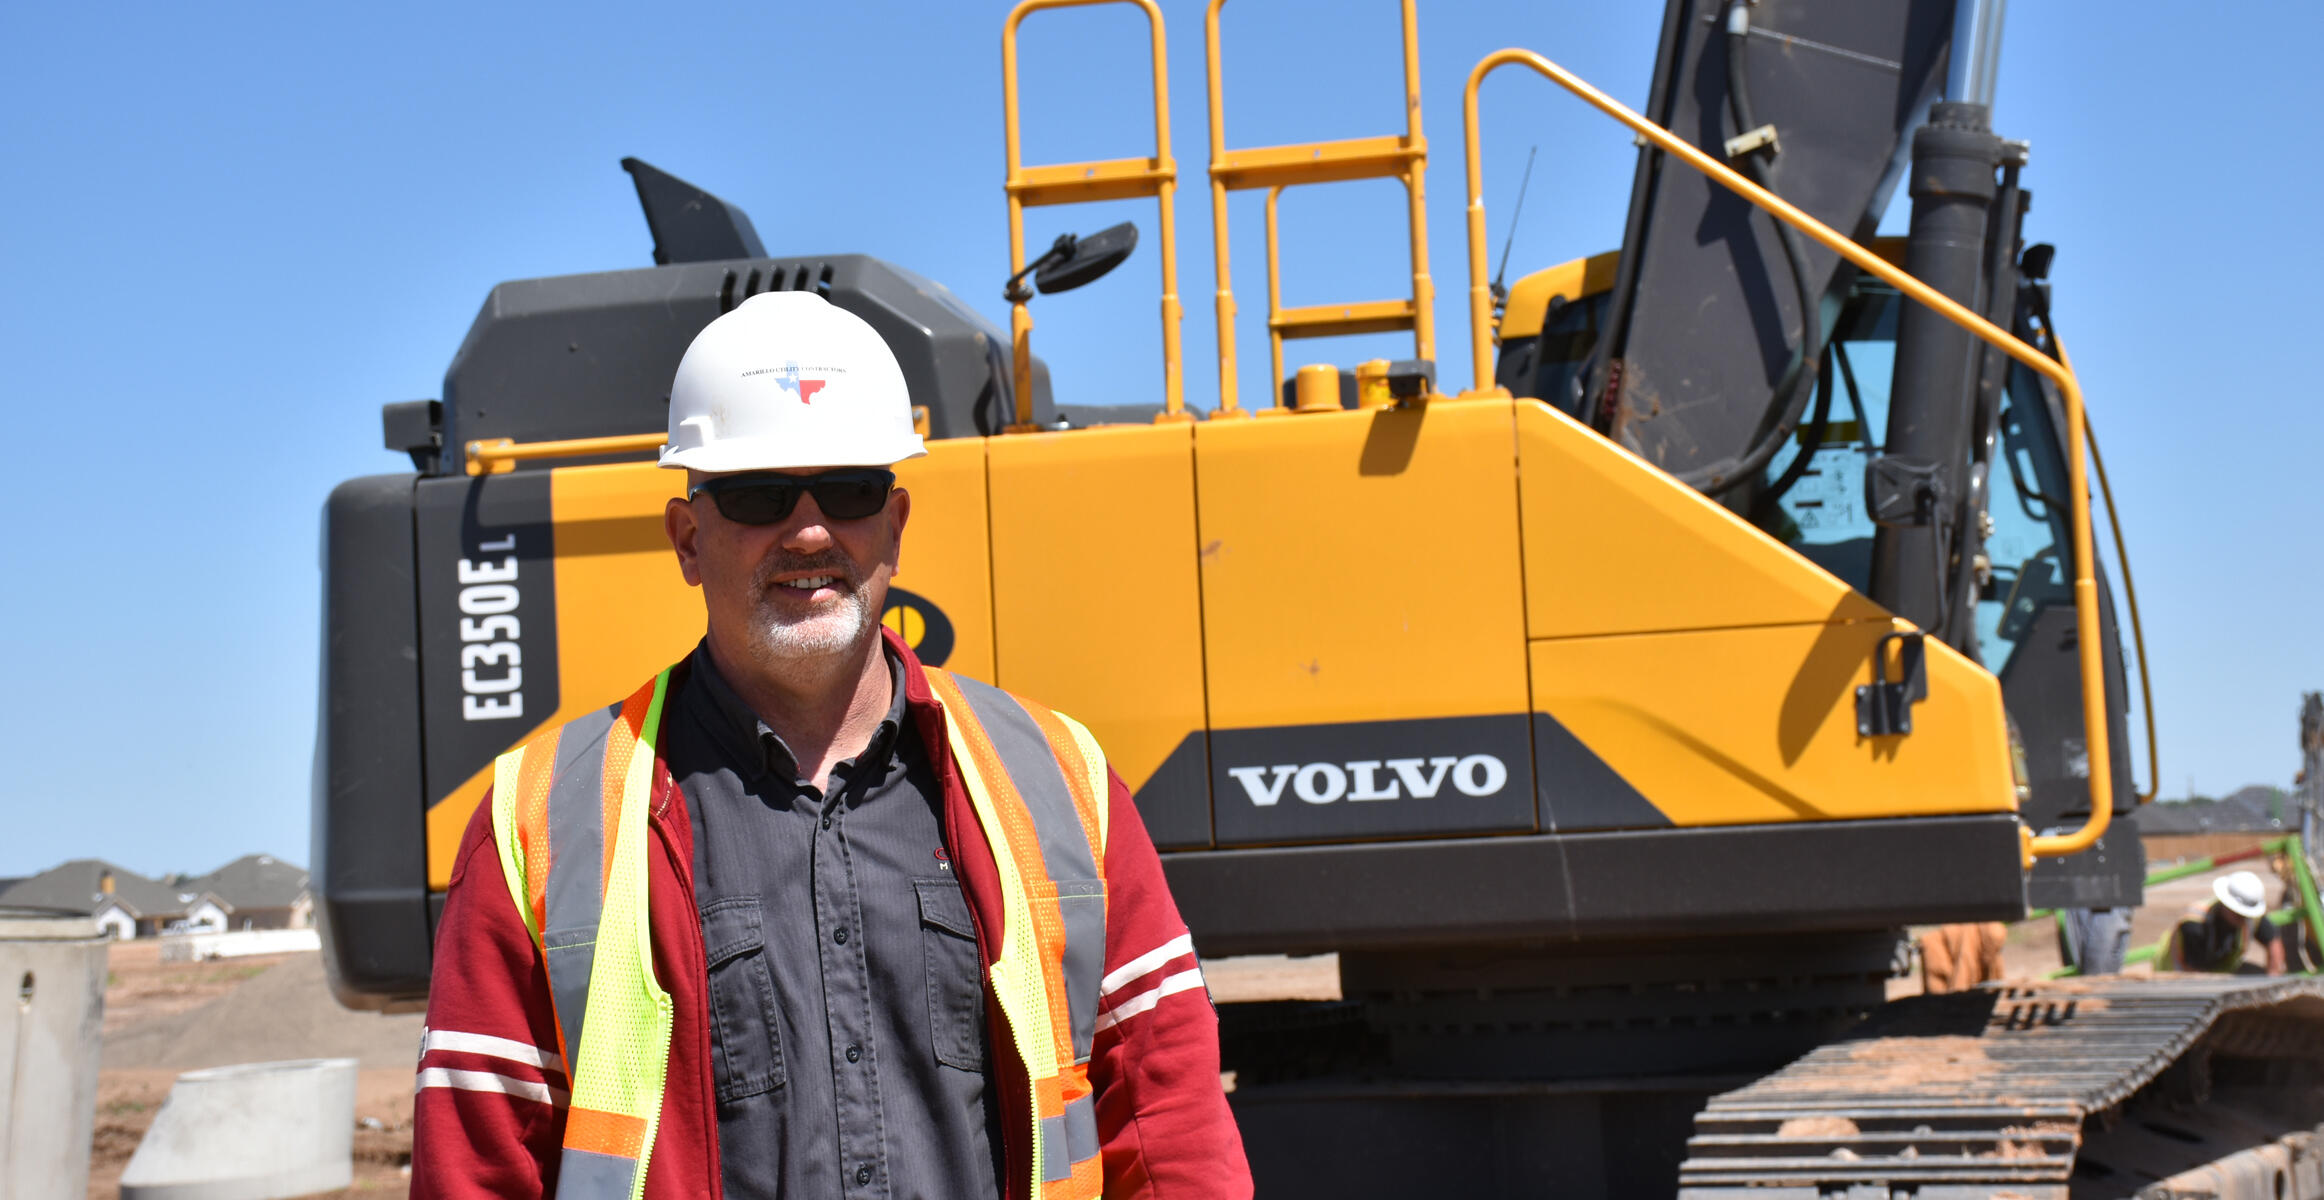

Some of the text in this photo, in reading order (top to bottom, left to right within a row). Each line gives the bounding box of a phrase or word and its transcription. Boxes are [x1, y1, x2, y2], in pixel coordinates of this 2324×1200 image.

[741, 368, 775, 378] AMARILLO
[775, 366, 799, 374] UTILITY
[458, 534, 523, 720] EC350E L
[1228, 754, 1507, 806] VOLVO
